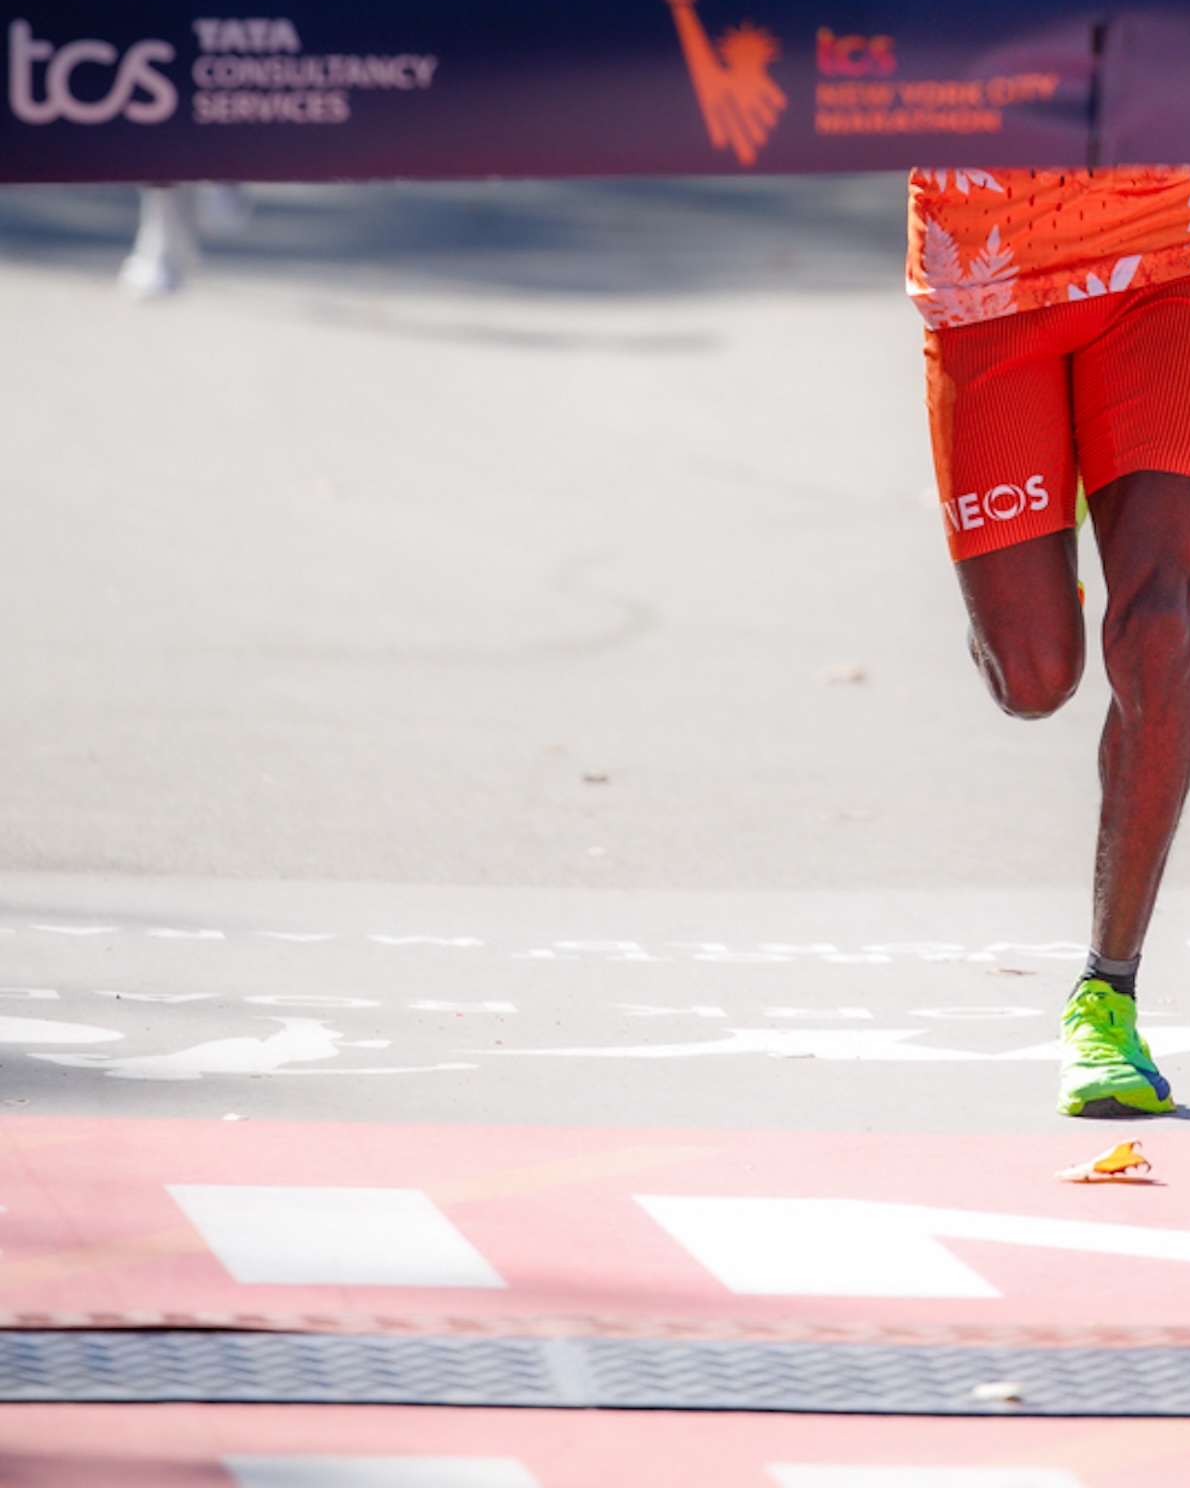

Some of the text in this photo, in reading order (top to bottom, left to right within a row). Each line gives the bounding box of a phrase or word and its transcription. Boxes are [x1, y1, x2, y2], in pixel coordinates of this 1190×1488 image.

[193, 18, 300, 53] TATA
[816, 27, 897, 77] tcs
[9, 18, 178, 124] tcs
[193, 54, 437, 89] CONSULTANCY
[193, 90, 350, 124] SERVICES
[815, 73, 1060, 107] NEW YORK CITY
[815, 110, 1002, 135] MARATHON
[942, 475, 1048, 536] NEOS
